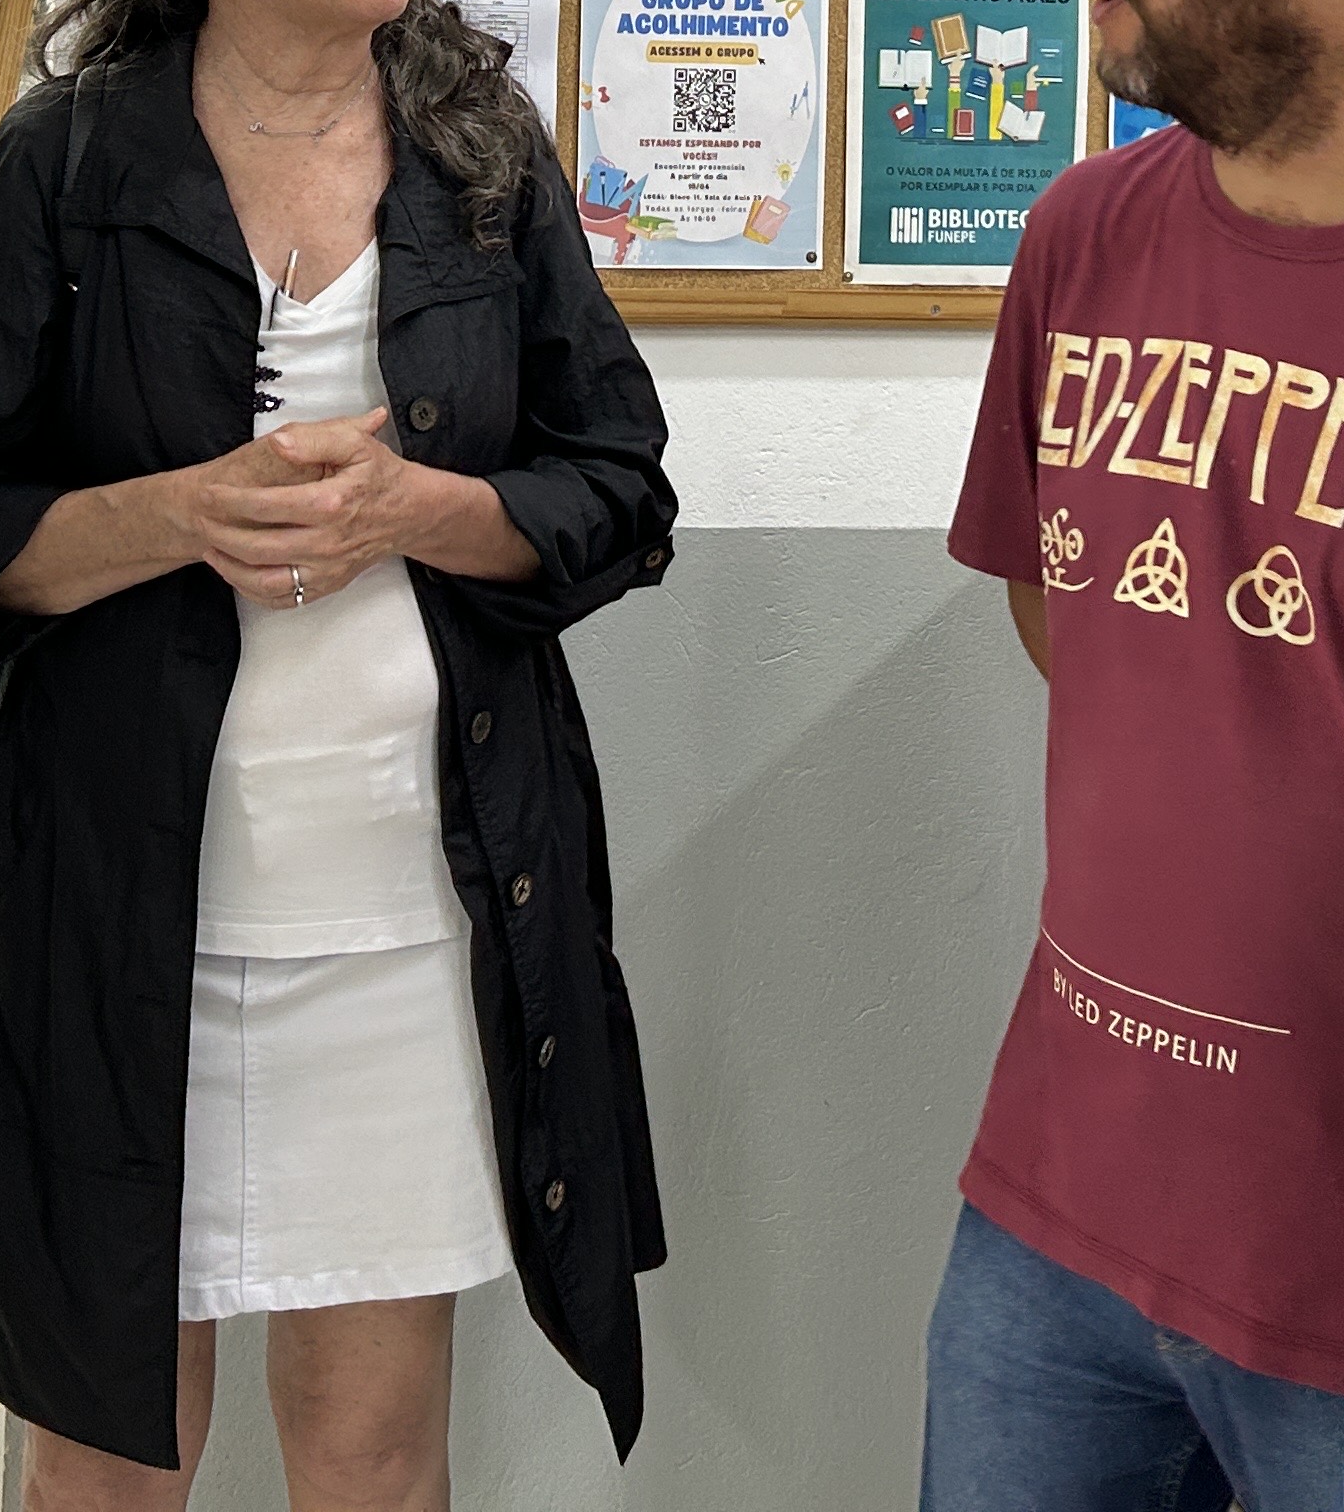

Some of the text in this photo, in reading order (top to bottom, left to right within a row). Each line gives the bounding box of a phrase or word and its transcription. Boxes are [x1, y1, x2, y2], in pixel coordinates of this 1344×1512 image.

[617, 13, 789, 38] ACOLHIMENTO
[650, 46, 754, 58] ACESSEM O GRUPO
[639, 139, 681, 147] ESTAMOS
[686, 140, 739, 148] ESPERANDO
[886, 167, 894, 175] O
[897, 167, 932, 176] VALOR
[936, 168, 950, 176] DA
[954, 168, 989, 177] MULTA
[992, 167, 997, 177] É
[1001, 169, 1014, 178] DE
[901, 182, 923, 191] POR
[926, 182, 980, 191] EXEMPLAR
[983, 183, 989, 191] E
[993, 183, 1013, 192] POR
[928, 208, 1030, 229] BIBLIOTEC
[928, 230, 976, 243] FUNEPE
[1053, 968, 1237, 1074] BY LED ZEPPELIN
